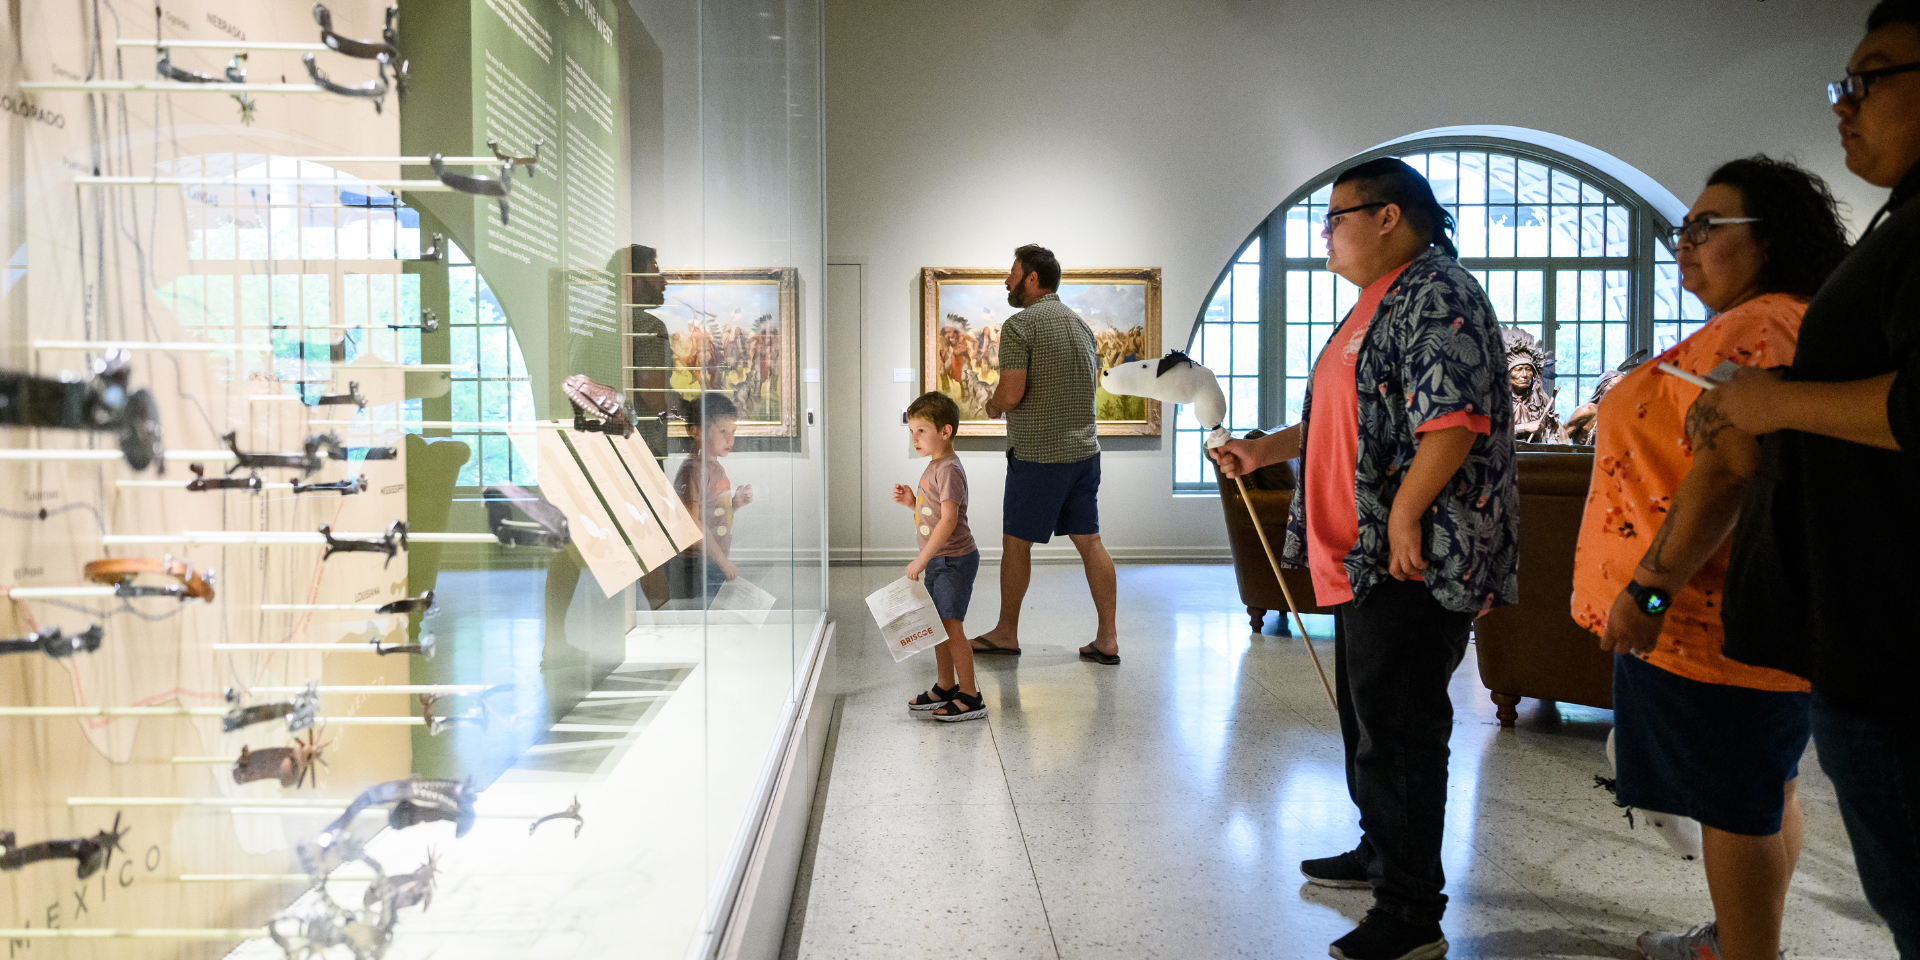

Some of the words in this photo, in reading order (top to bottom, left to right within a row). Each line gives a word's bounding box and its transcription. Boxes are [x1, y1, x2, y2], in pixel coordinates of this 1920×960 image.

[206, 11, 246, 41] NEBRASKA
[585, 0, 596, 27] THE
[597, 12, 613, 47] WEST
[0, 94, 65, 129] OLORADO
[355, 586, 380, 603] LOUISIANA
[900, 627, 934, 647] BRISCOE
[10, 844, 161, 958] MEXICO
